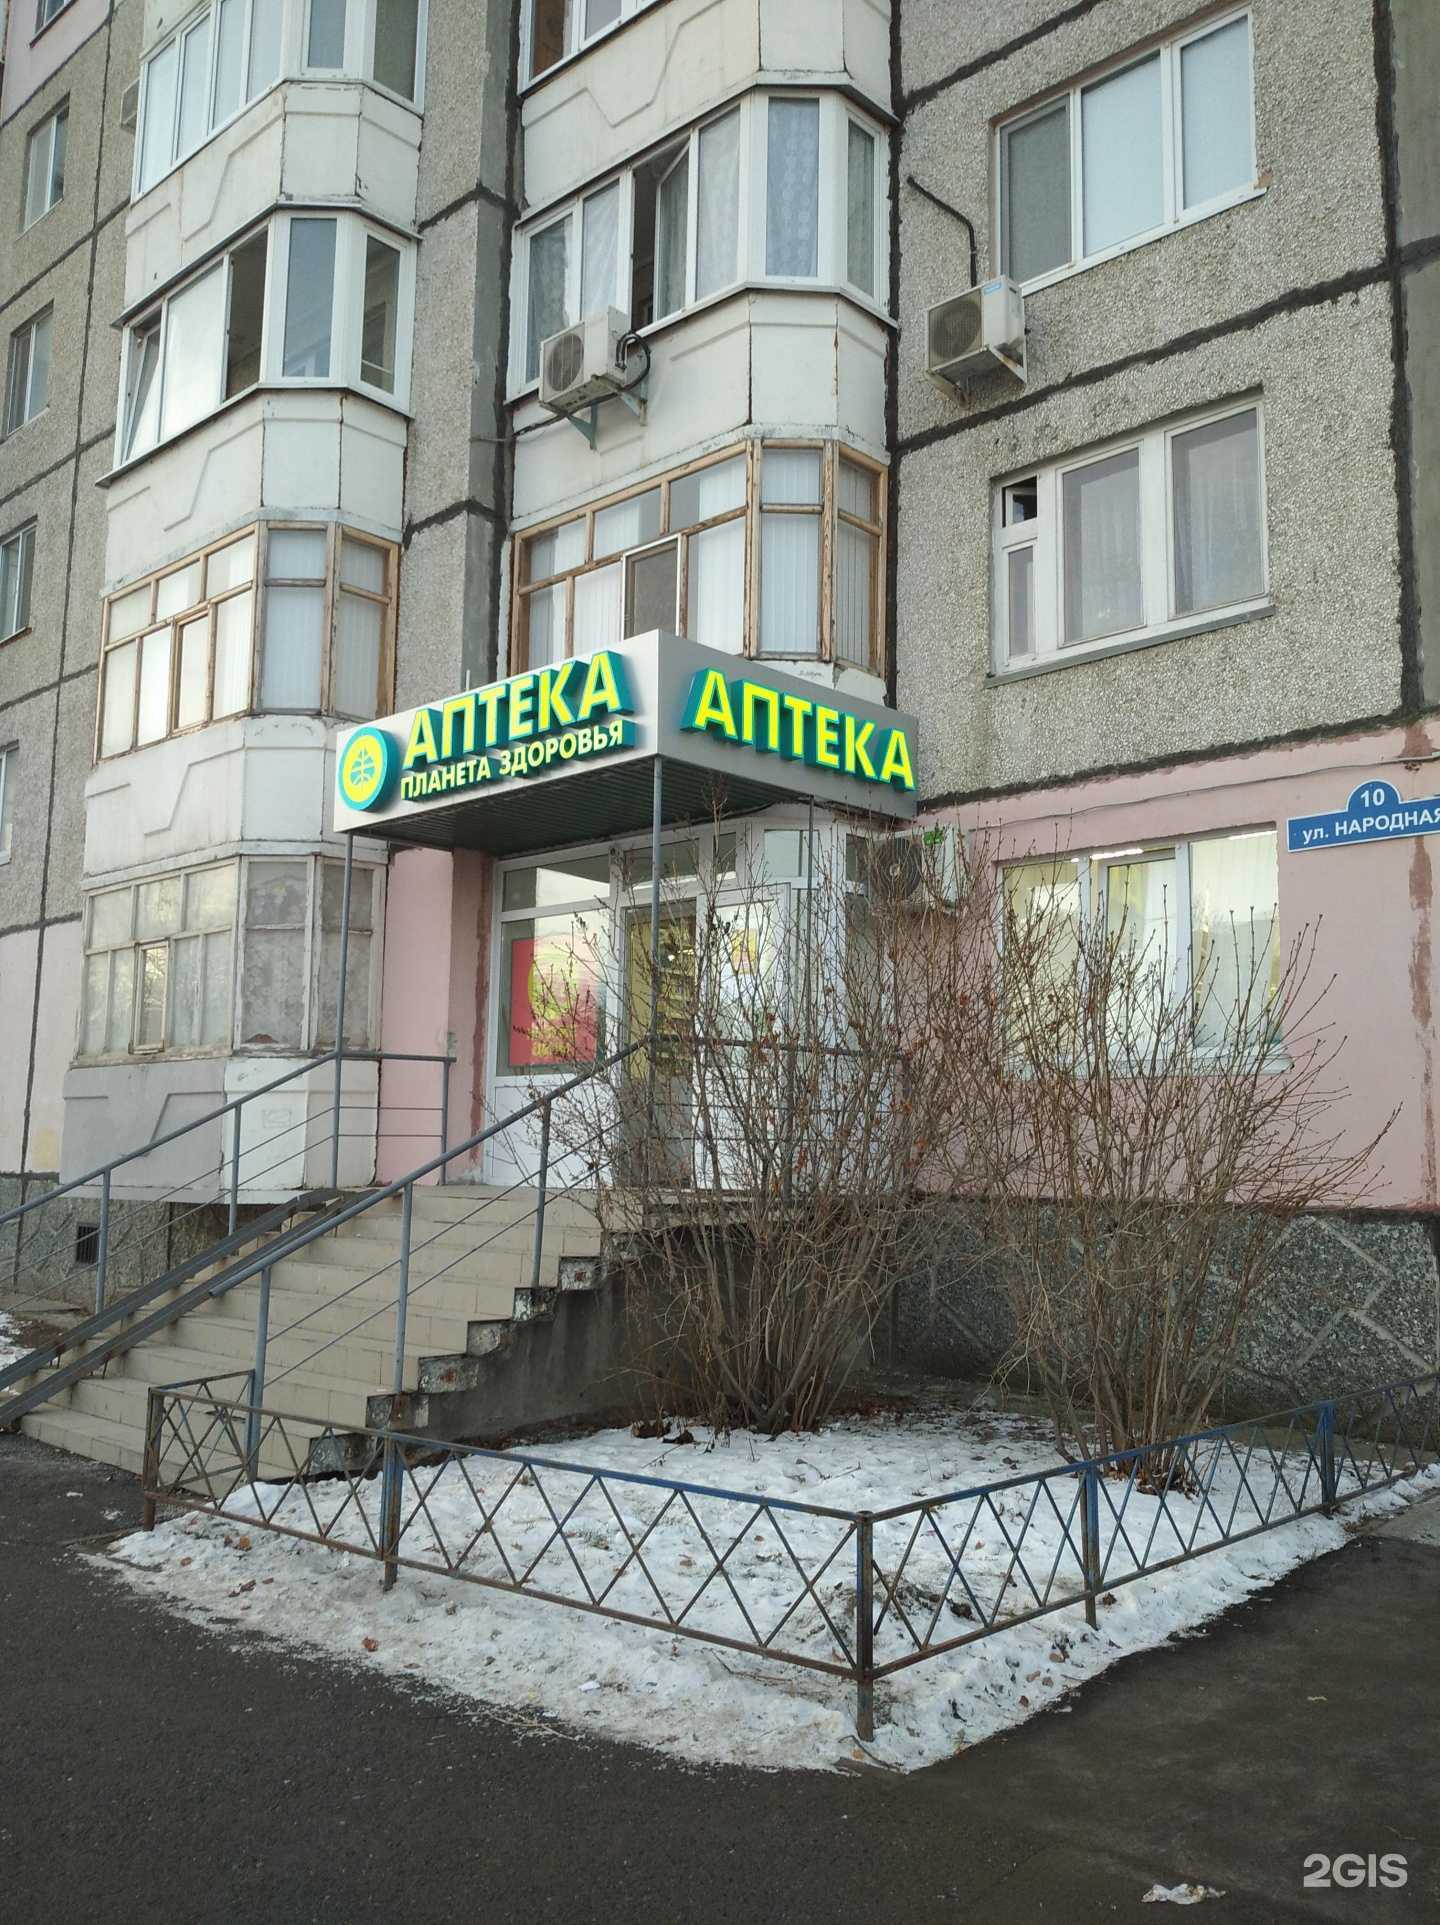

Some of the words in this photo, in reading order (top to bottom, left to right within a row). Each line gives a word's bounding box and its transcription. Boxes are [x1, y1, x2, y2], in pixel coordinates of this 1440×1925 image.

[402, 650, 624, 770] АПТЕКА
[690, 668, 917, 792] АПТЕКА
[400, 756, 492, 800] ПЛАНЕТА
[498, 719, 624, 777] ЗДОРОВЬЯ
[1360, 788, 1385, 808] 10
[1302, 827, 1329, 845] ул.
